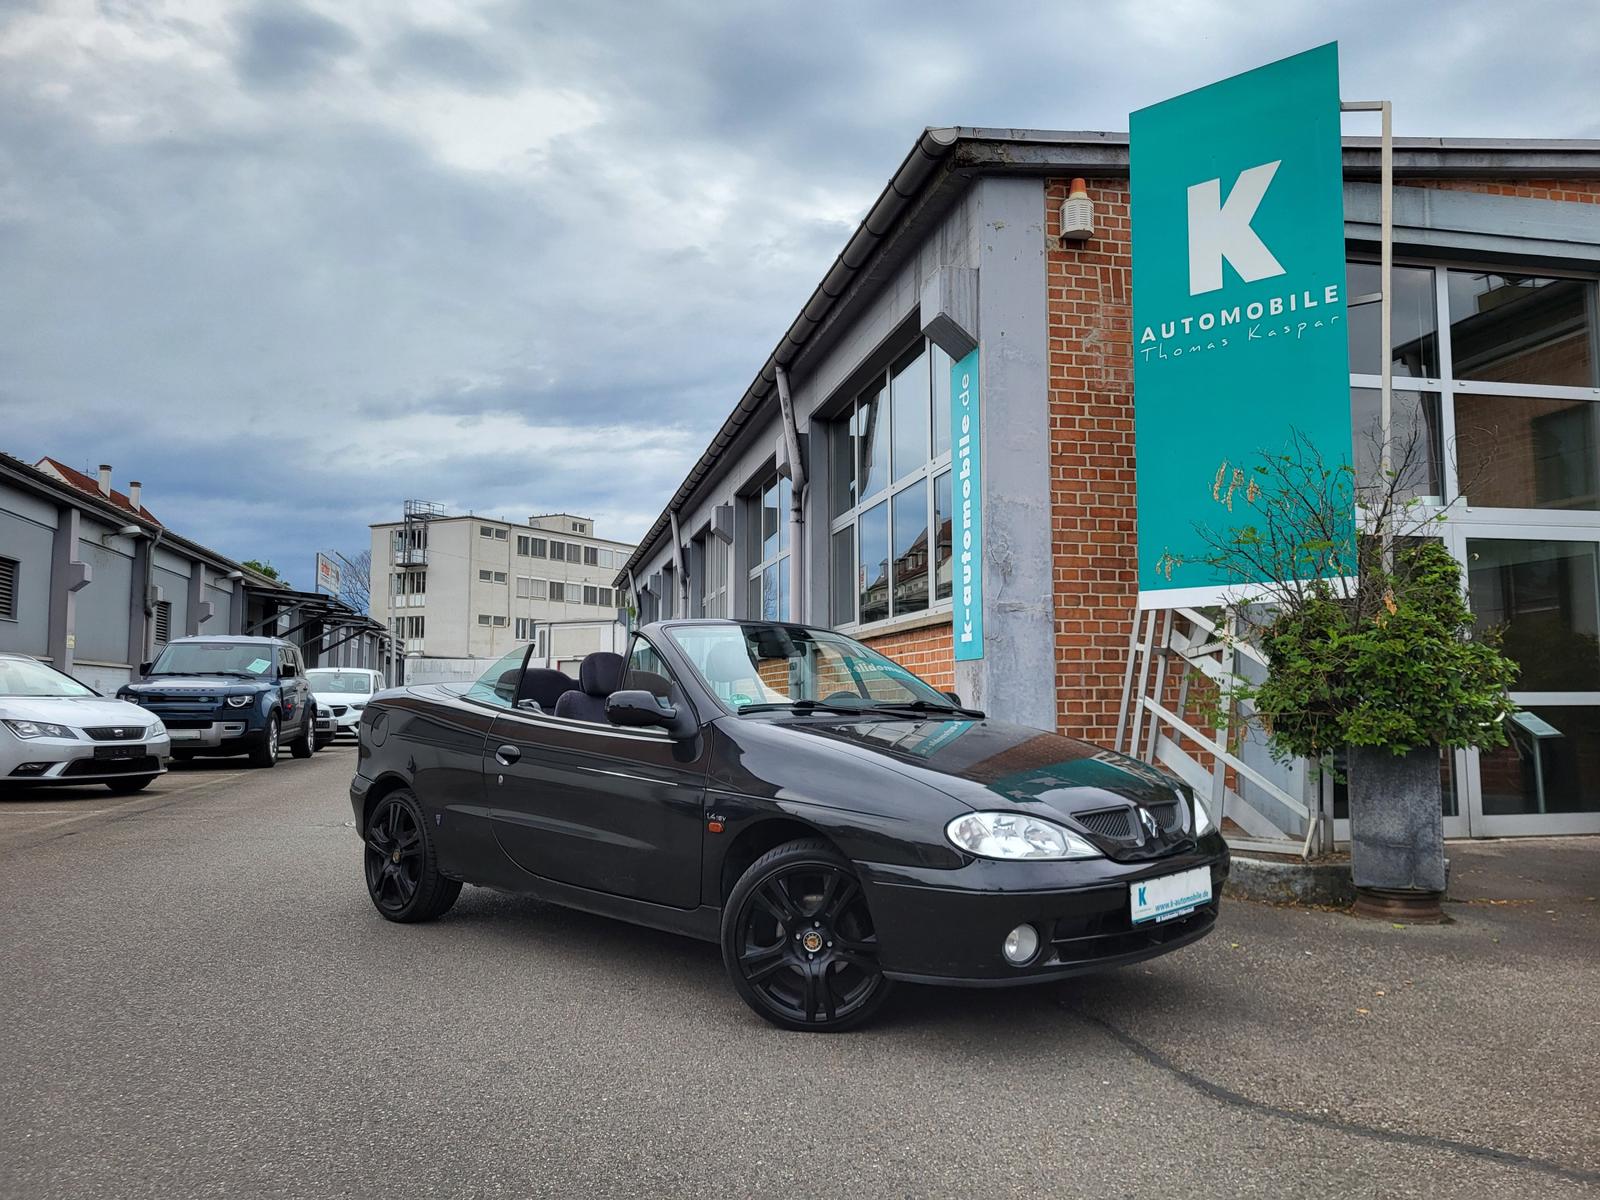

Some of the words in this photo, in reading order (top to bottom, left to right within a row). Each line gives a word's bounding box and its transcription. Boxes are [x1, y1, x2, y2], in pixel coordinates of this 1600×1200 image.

[1187, 159, 1287, 297] K
[1140, 284, 1339, 344] AUTOMOBILE
[1140, 337, 1229, 362] Thomas
[1248, 315, 1340, 341] Kaspar
[958, 373, 974, 643] k-automobile.de
[1138, 886, 1147, 907] K
